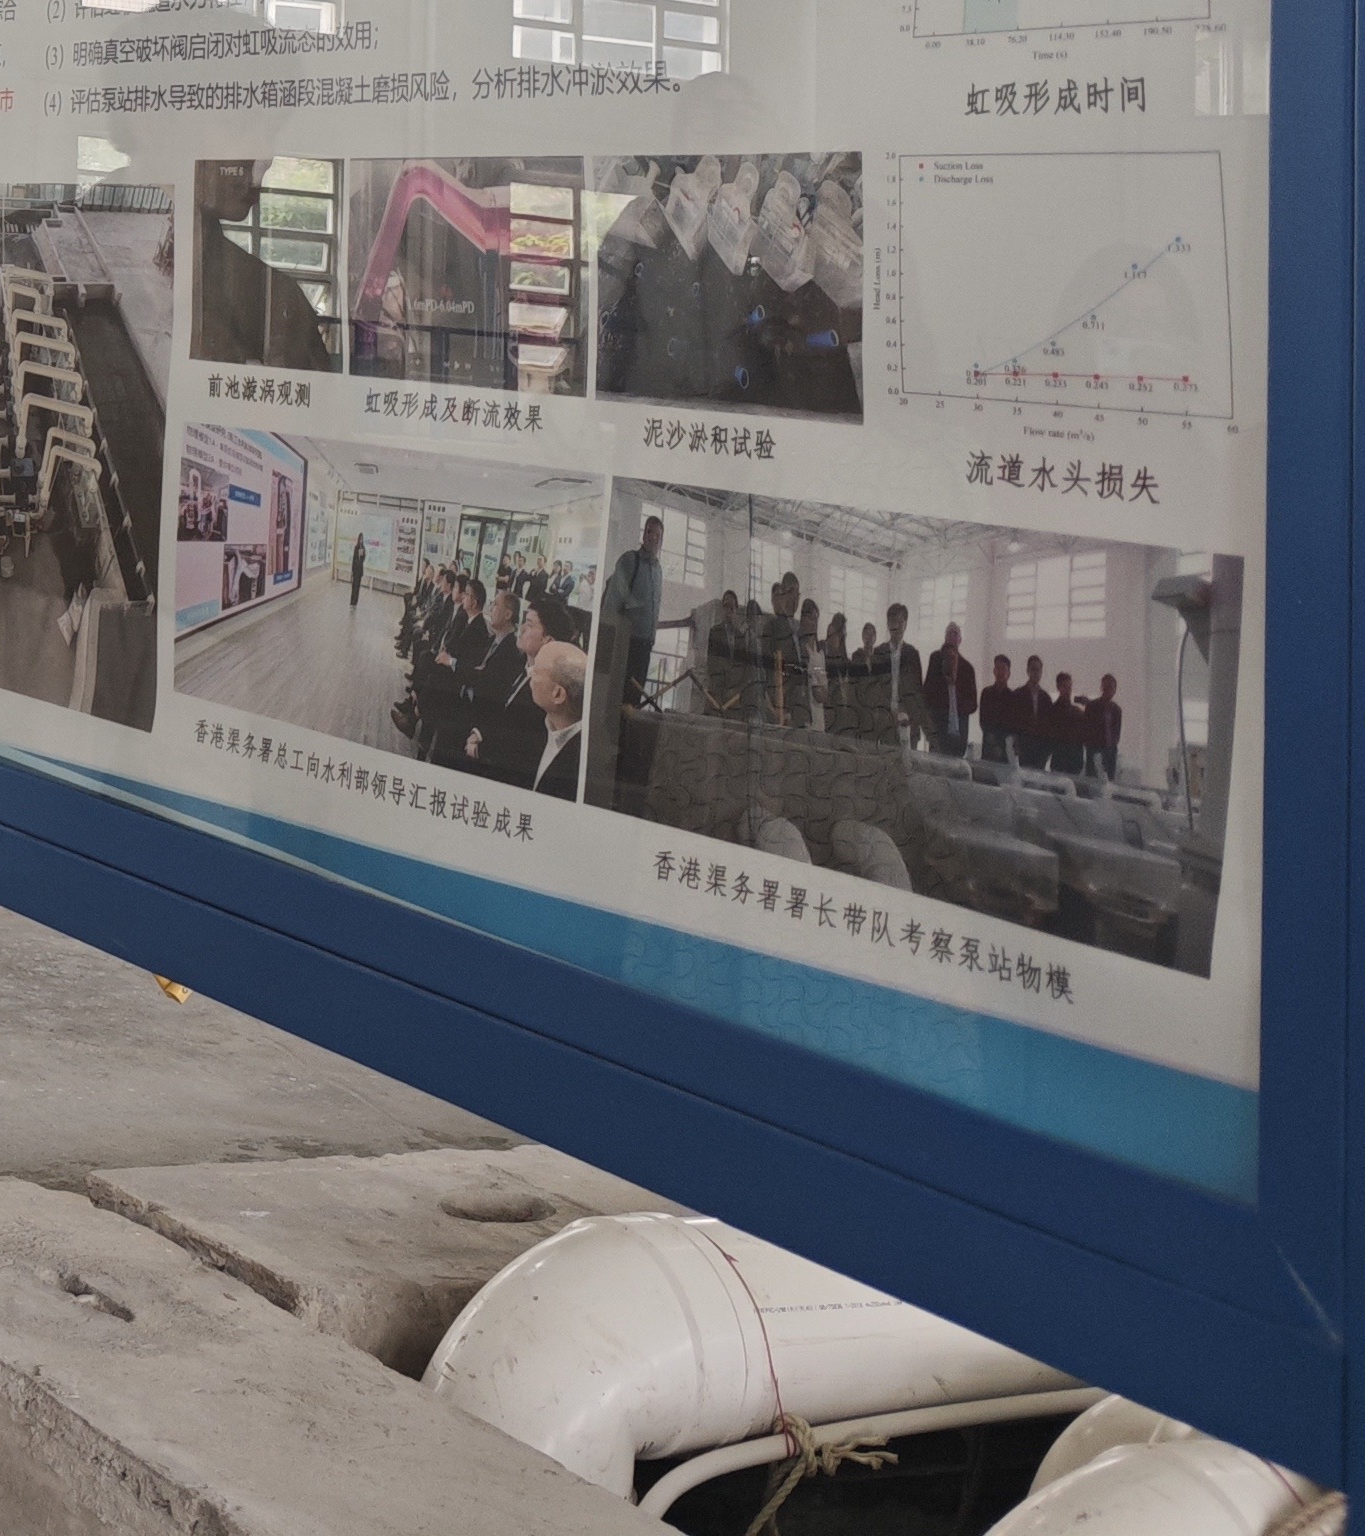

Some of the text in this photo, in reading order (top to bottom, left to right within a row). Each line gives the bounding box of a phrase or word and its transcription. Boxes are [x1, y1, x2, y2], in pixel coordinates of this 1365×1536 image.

[47, 0, 66, 24] (2)
[45, 44, 64, 70] (3)
[1032, 50, 1054, 61] Time
[43, 89, 62, 116] (4)
[965, 76, 1148, 118] 虹吸形成时间
[934, 174, 973, 185] Discharge
[208, 373, 311, 410] 前池漩涡观测
[364, 388, 544, 433] 虹吸形成及断流效果
[643, 417, 777, 461] 泥沙淤积试验
[1023, 426, 1045, 437] Flow
[965, 450, 1160, 505] 流道水头损失
[194, 718, 535, 842] 香港渠务署总工向水利部领导汇报试验成果
[653, 850, 1074, 1004] 香港渠务署署长带队考察泵站物模
